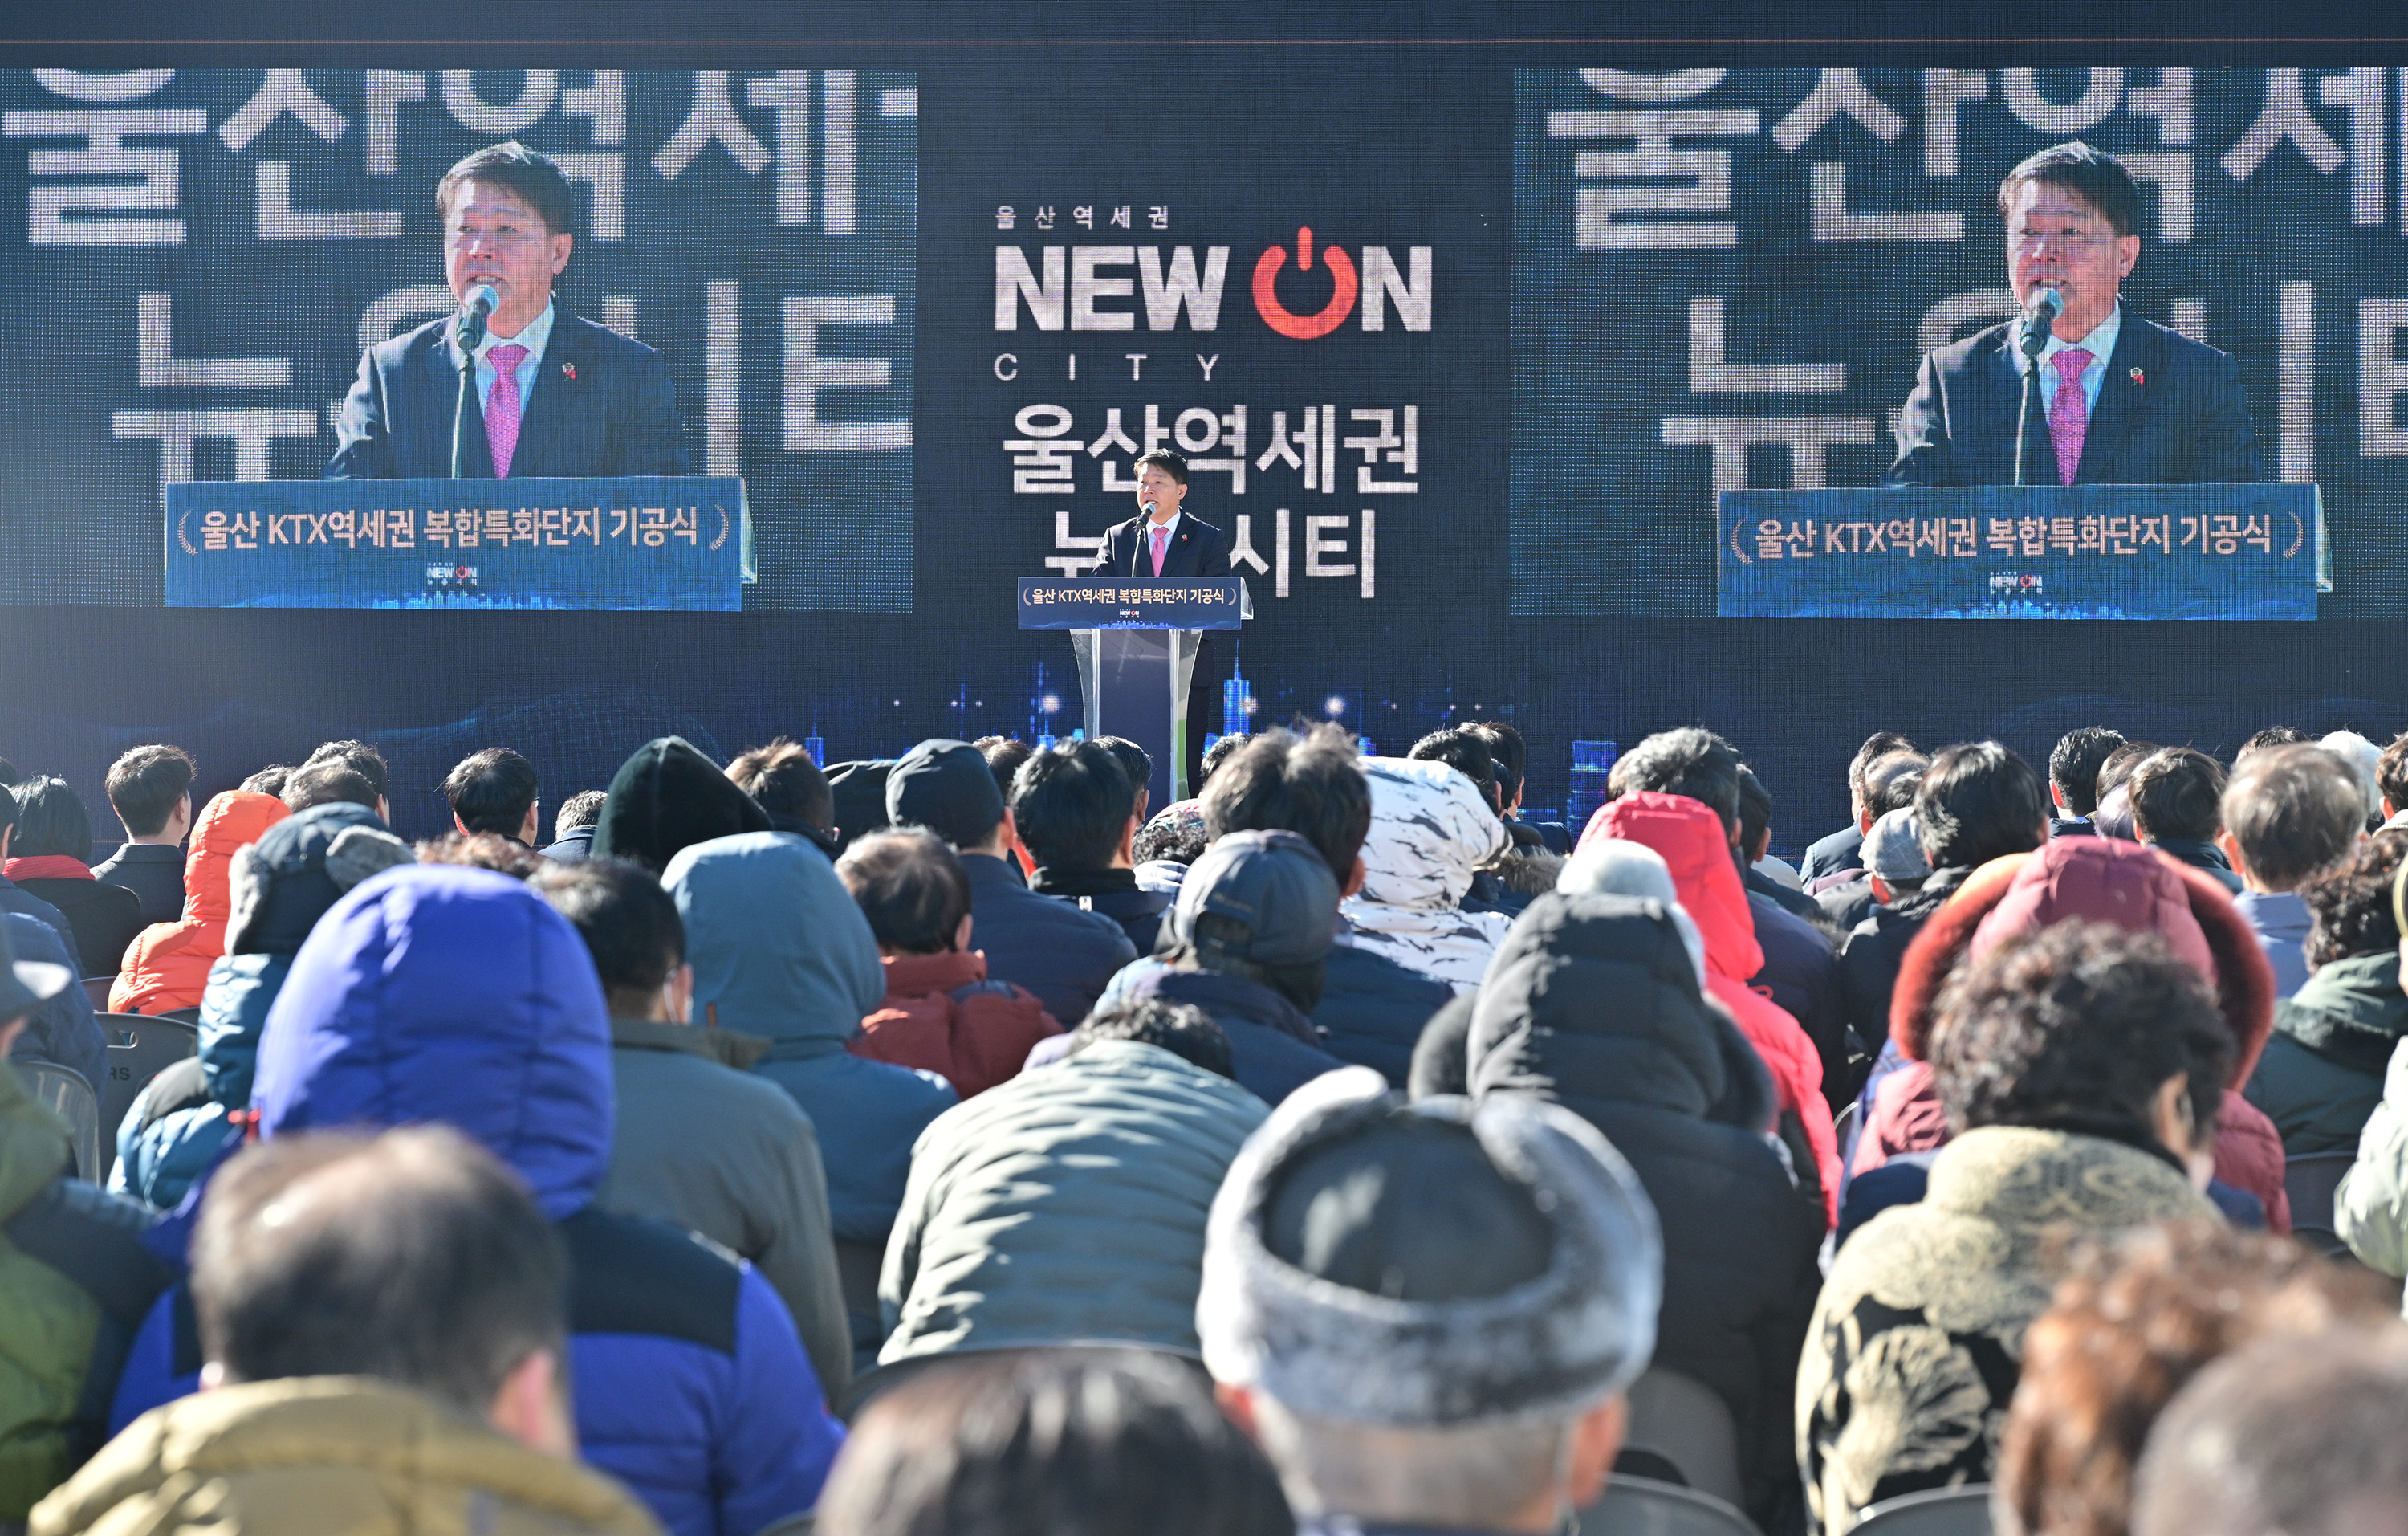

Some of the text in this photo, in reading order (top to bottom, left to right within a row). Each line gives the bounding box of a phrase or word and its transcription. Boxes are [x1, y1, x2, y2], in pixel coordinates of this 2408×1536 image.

[0, 69, 918, 246] 울산역세
[995, 206, 1169, 230] 울산역세권
[995, 226, 1433, 340] NEW ON
[994, 352, 1219, 381] CITY
[1003, 403, 1419, 495] 울산역세권
[201, 507, 698, 549] 울산 KTX역세권 복합특화단지 기공식
[1755, 514, 2272, 559] 울산 KTX역세권 복합특화단지 기공식
[427, 567, 454, 578] NEW
[1990, 576, 2018, 587] NEW
[1031, 588, 1225, 605] 울산 KTX역세권 복합특화단지 기공식
